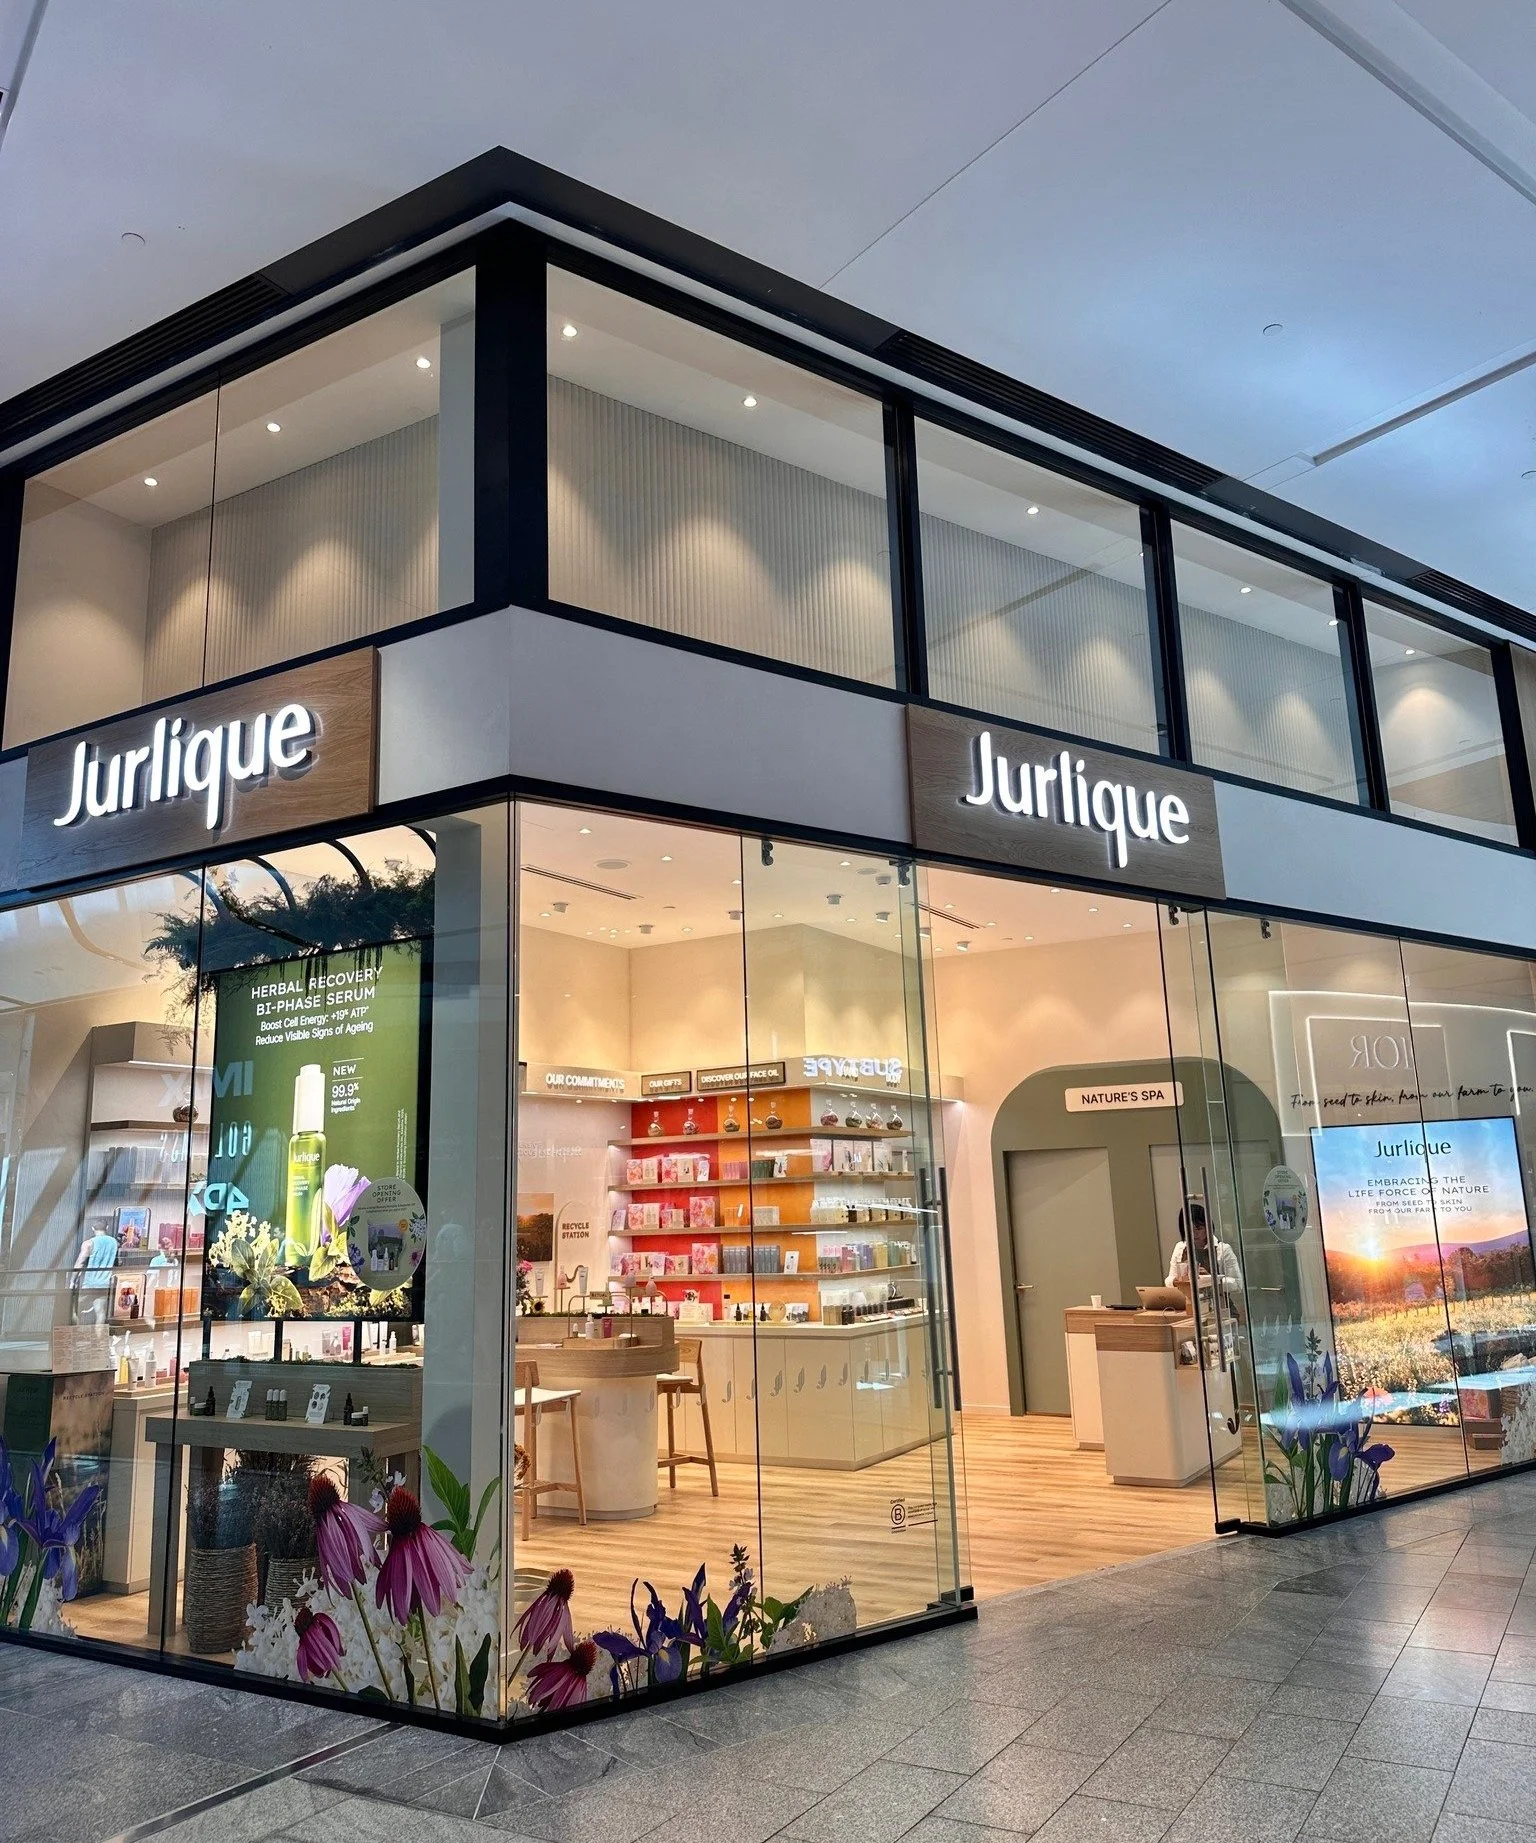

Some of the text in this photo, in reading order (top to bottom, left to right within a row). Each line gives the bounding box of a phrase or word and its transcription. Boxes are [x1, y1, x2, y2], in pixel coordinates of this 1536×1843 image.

[54, 703, 312, 830] Jurlique
[966, 731, 1190, 868] Jurlique
[251, 966, 384, 1000] HERBAL RECOVERY
[256, 986, 375, 1016] BI-PHASE SERUM
[260, 1018, 283, 1032] Boost
[283, 1016, 299, 1029] Cell
[299, 1014, 329, 1027] Energy:
[255, 1021, 374, 1046] Reduce Visible Signs of Ageing
[333, 1064, 357, 1077] NEW
[701, 1073, 734, 1084] DISCOVER
[749, 1070, 767, 1079] FACE
[767, 1069, 780, 1077] OIL
[545, 1073, 625, 1090] OUR COMMITMENTS
[648, 1078, 683, 1088] OUR GIFTS
[331, 1082, 360, 1099] 99.9%
[1081, 1090, 1165, 1105] NATURE'S SPA
[1323, 1093, 1347, 1108] seed
[1348, 1093, 1363, 1106] to
[1399, 1091, 1429, 1105] from
[1432, 1089, 1453, 1099] our
[1457, 1085, 1489, 1101] farm
[1489, 1083, 1505, 1096] to
[1374, 1139, 1452, 1163] Jurlique
[1367, 1175, 1466, 1187] EMBRACING THE
[371, 1189, 402, 1198] OPENING
[1348, 1189, 1374, 1198] LIFE
[1379, 1187, 1417, 1197] FORCE
[1442, 1185, 1490, 1195] NATURE
[1368, 1207, 1391, 1215] FROM
[562, 1221, 590, 1230] RECYCLE
[561, 1230, 590, 1239] STATION
